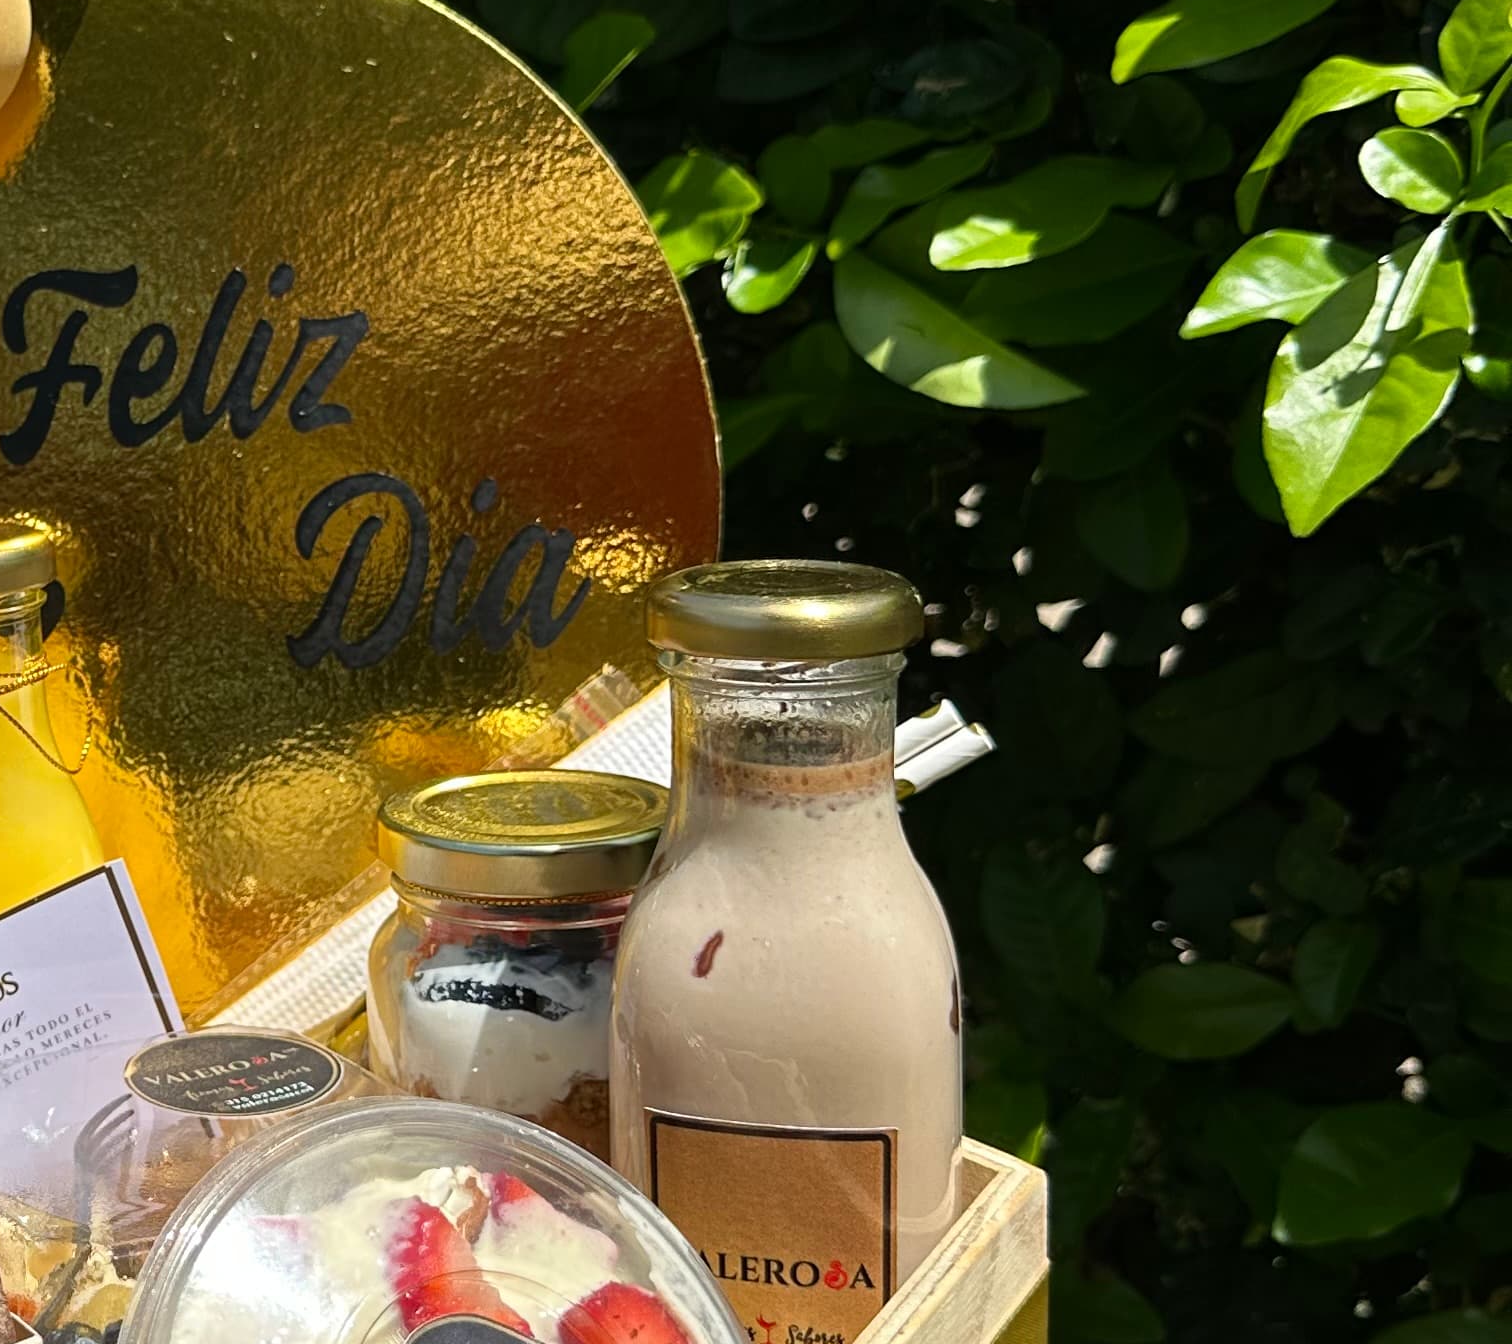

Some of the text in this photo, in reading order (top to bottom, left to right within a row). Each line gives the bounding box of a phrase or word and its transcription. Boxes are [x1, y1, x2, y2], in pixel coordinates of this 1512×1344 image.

[25, 1014, 70, 1042] TODO
[75, 1002, 93, 1017] EL
[41, 1010, 112, 1050] MERECES
[699, 1249, 876, 1291] ALEROSA
